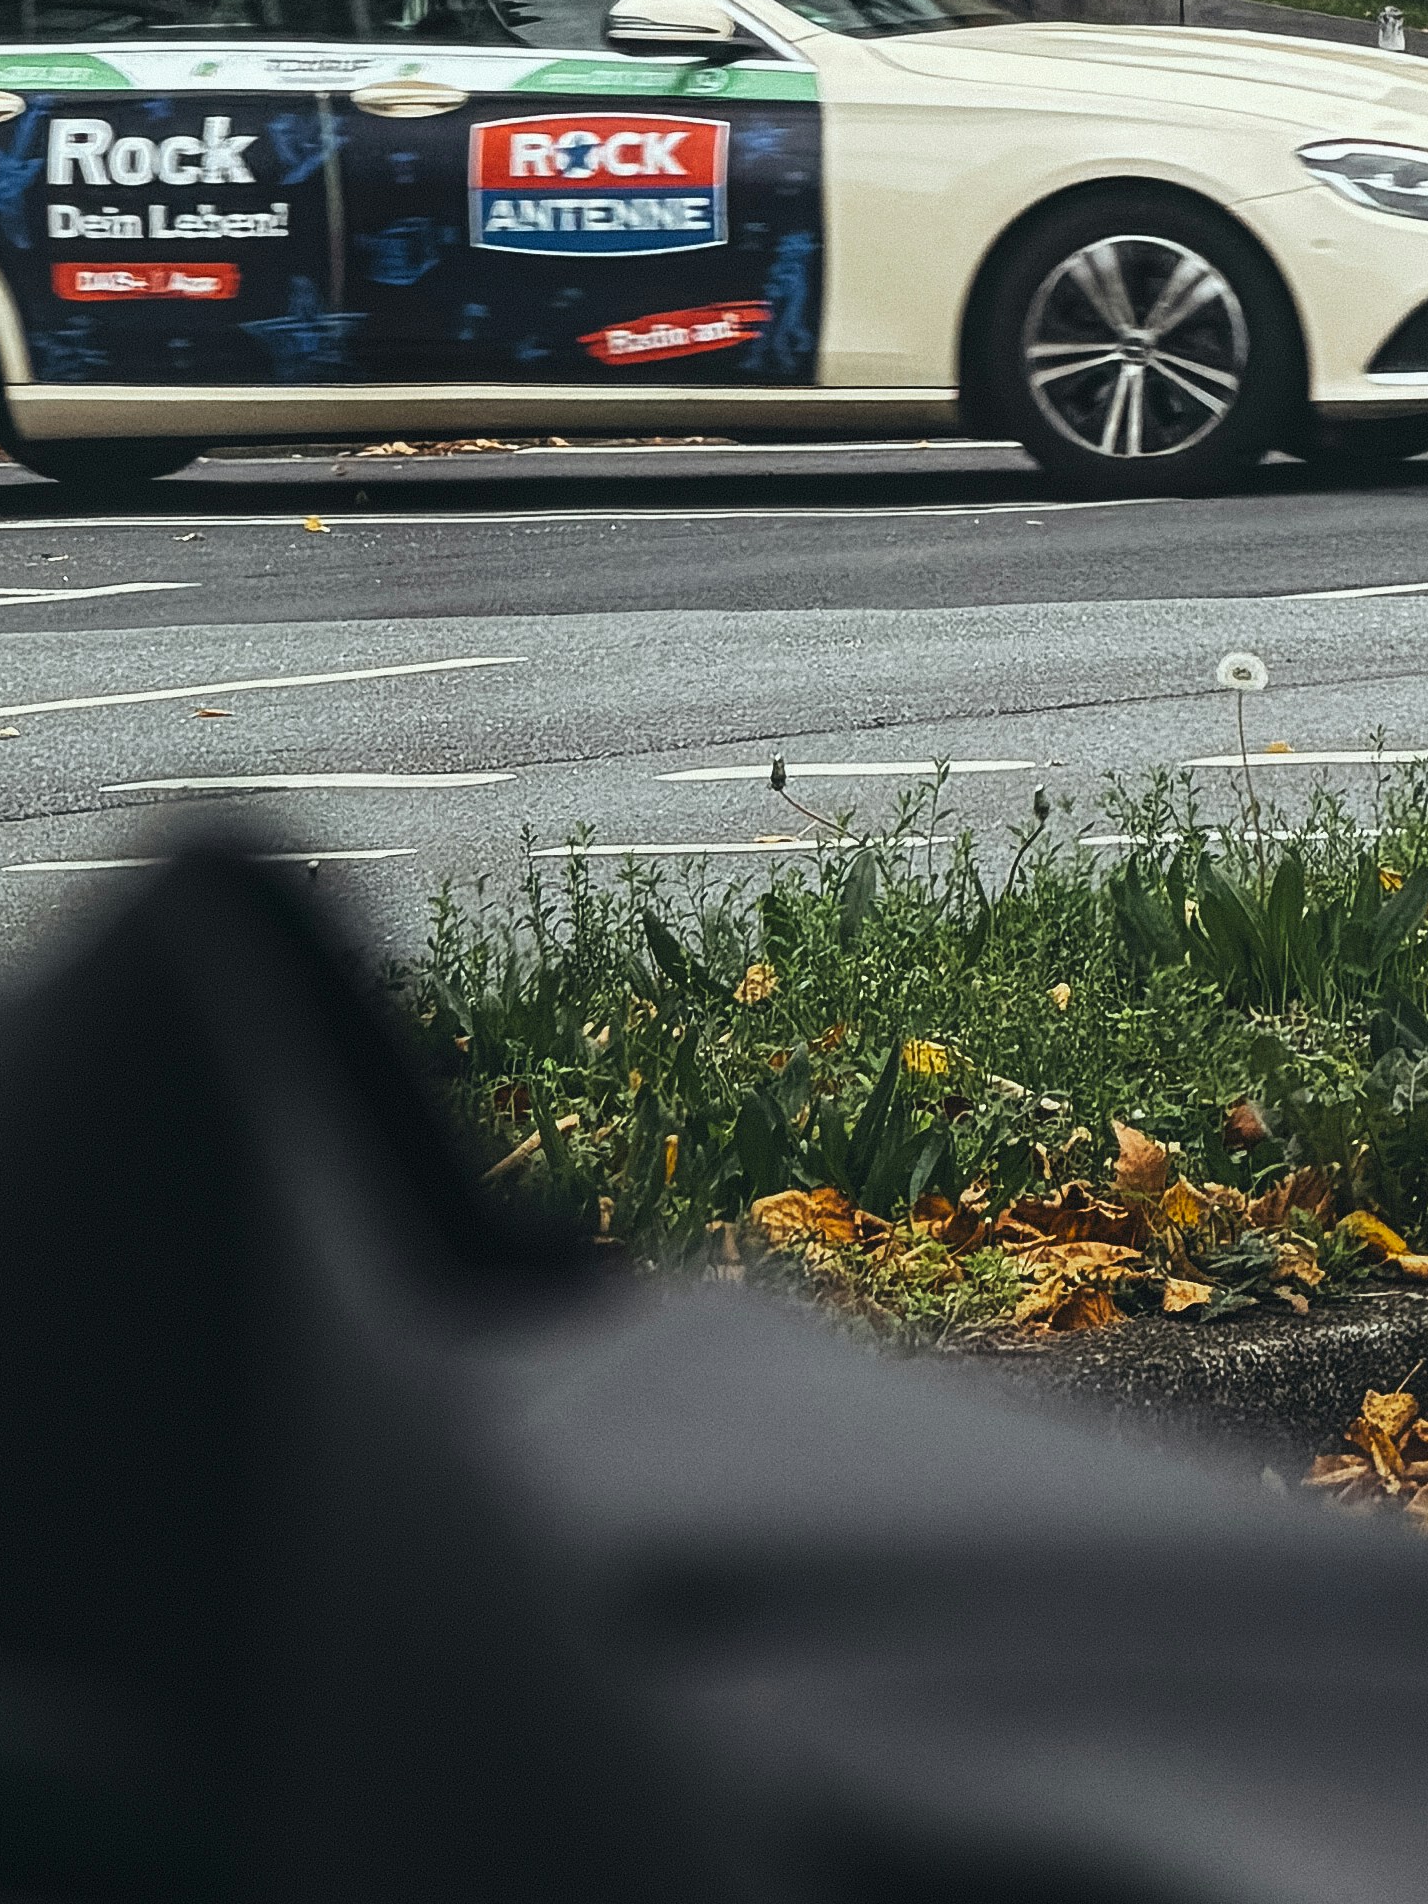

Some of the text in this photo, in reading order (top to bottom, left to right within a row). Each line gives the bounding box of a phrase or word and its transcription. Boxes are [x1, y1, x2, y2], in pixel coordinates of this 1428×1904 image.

[46, 116, 259, 186] Rock
[508, 130, 690, 179] ROCK
[47, 202, 290, 239] Dein Leben!
[484, 197, 712, 232] ANTENNE
